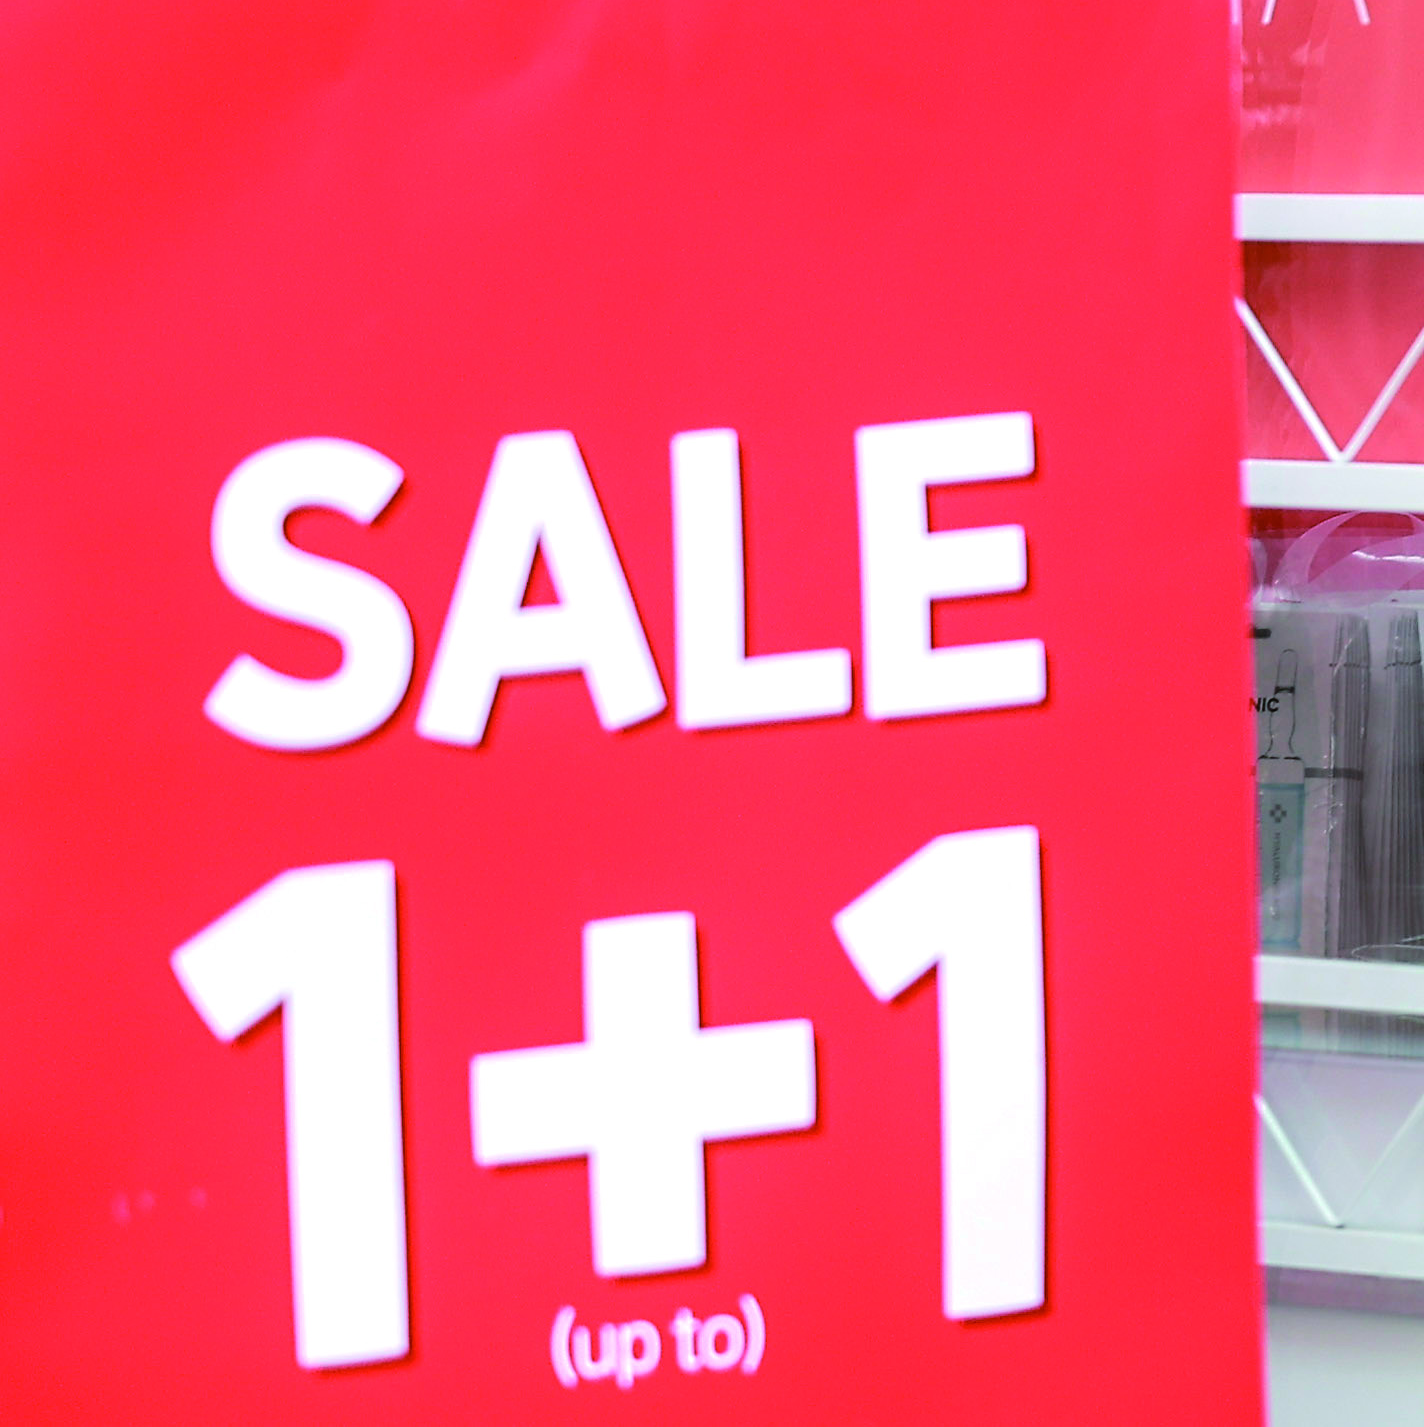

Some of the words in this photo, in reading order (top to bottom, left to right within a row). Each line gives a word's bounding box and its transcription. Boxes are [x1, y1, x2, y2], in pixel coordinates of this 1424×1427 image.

[200, 411, 1048, 752] SALE
[168, 824, 1047, 1371] 1+1
[549, 1303, 662, 1389] (up
[671, 1293, 766, 1376] to)
